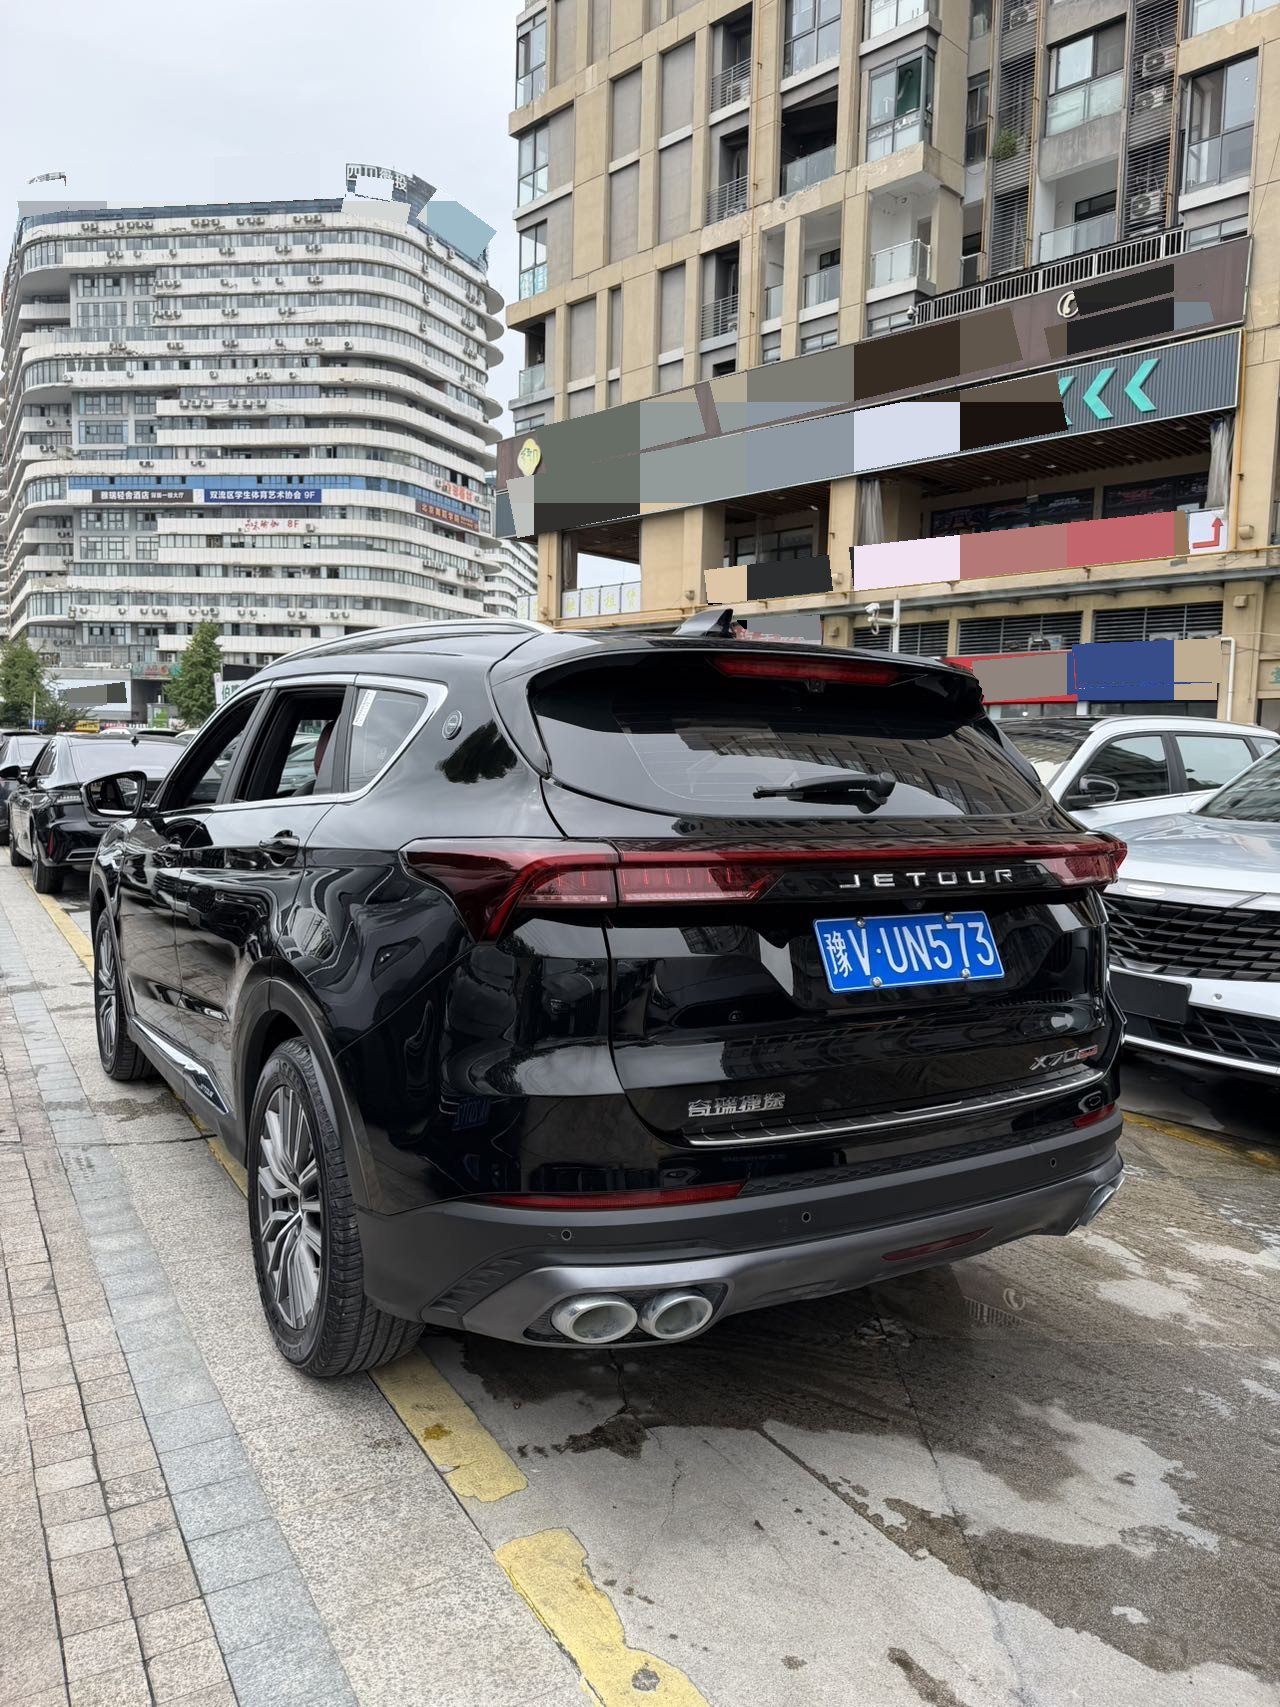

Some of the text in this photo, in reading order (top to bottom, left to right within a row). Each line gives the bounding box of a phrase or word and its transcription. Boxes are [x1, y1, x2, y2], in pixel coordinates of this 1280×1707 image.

[209, 490, 316, 500] 双流区学生体育艺术协会 9F
[287, 519, 300, 529] 8F
[839, 868, 1013, 889] JETOUR
[823, 921, 995, 978] 豫V·UN573
[687, 1092, 786, 1118] 奇瑞捷途
